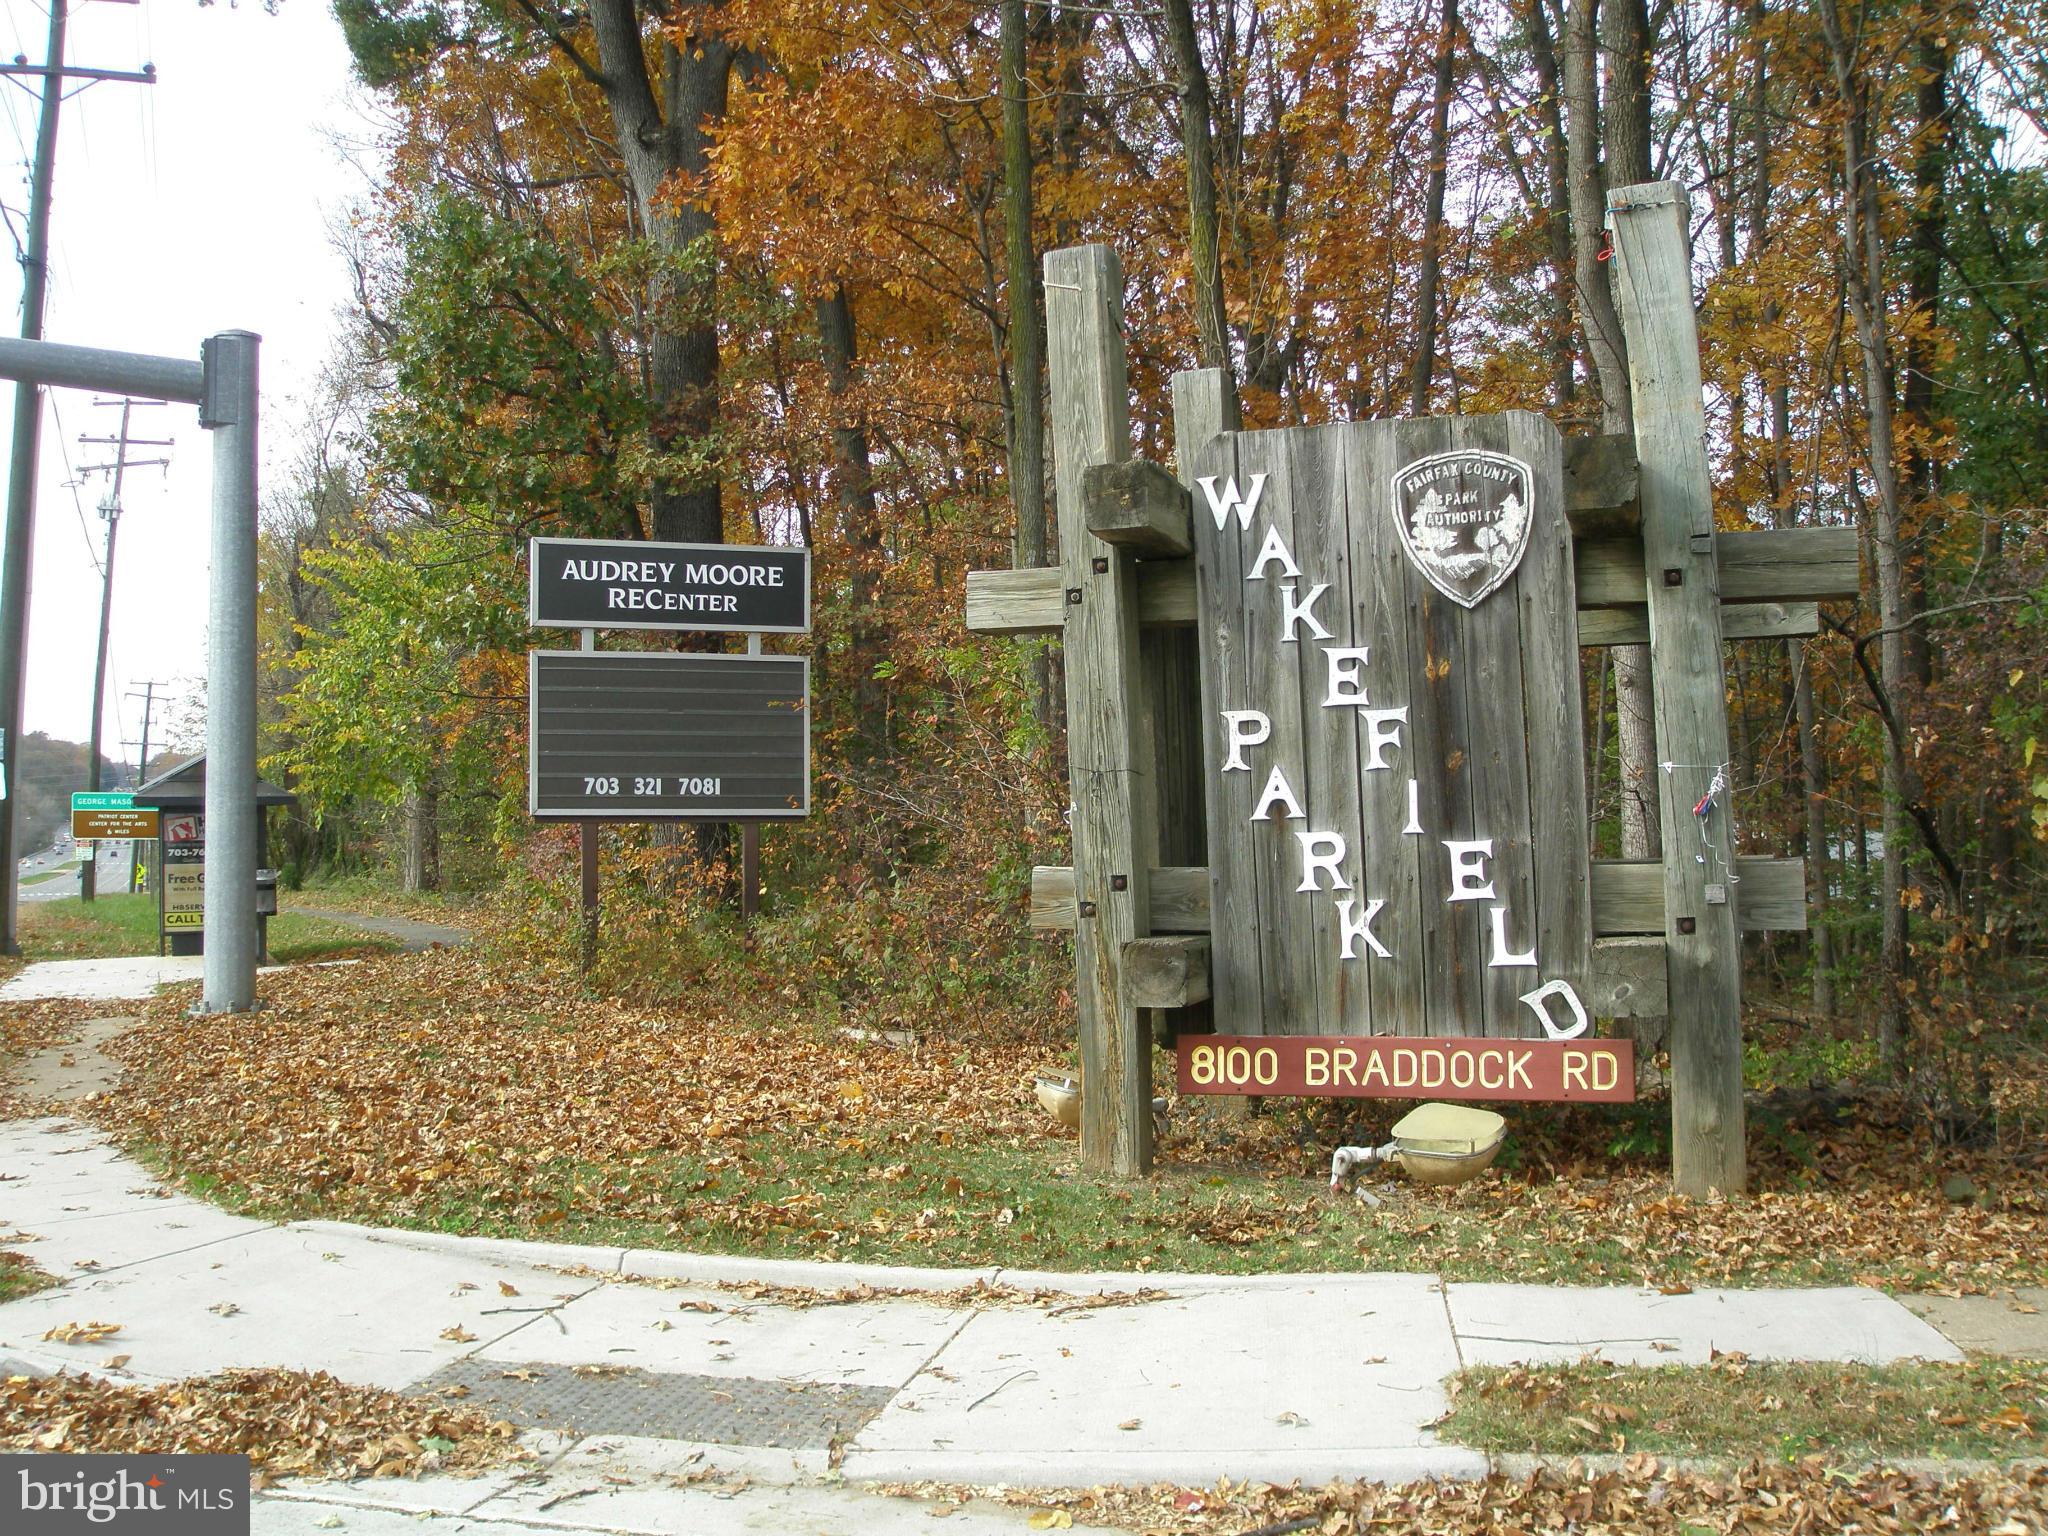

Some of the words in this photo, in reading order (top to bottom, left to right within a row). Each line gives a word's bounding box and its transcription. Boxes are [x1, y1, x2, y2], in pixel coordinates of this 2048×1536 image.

[1405, 463, 1460, 494] FAIRFAX
[1464, 462, 1518, 485] COUNTY
[1444, 490, 1479, 506] PARK
[1426, 510, 1501, 527] AUTHORITY
[561, 559, 677, 584] AUDREY
[685, 563, 785, 587] MOORE
[607, 588, 738, 612] RECENTER
[1196, 472, 1589, 1040] WAKEFIELD
[584, 777, 620, 796] 703
[633, 777, 662, 796] 321
[678, 777, 721, 796] 7081
[77, 798, 106, 806] GEORGE
[110, 798, 132, 806] MASO
[1220, 710, 1393, 960] PARK
[167, 848, 206, 857] 703-76
[168, 873, 196, 884] Free
[166, 914, 196, 924] CALL
[1190, 1044, 1279, 1086] 8100
[1304, 1046, 1534, 1091] BRADDOCK
[1561, 1049, 1619, 1092] RD
